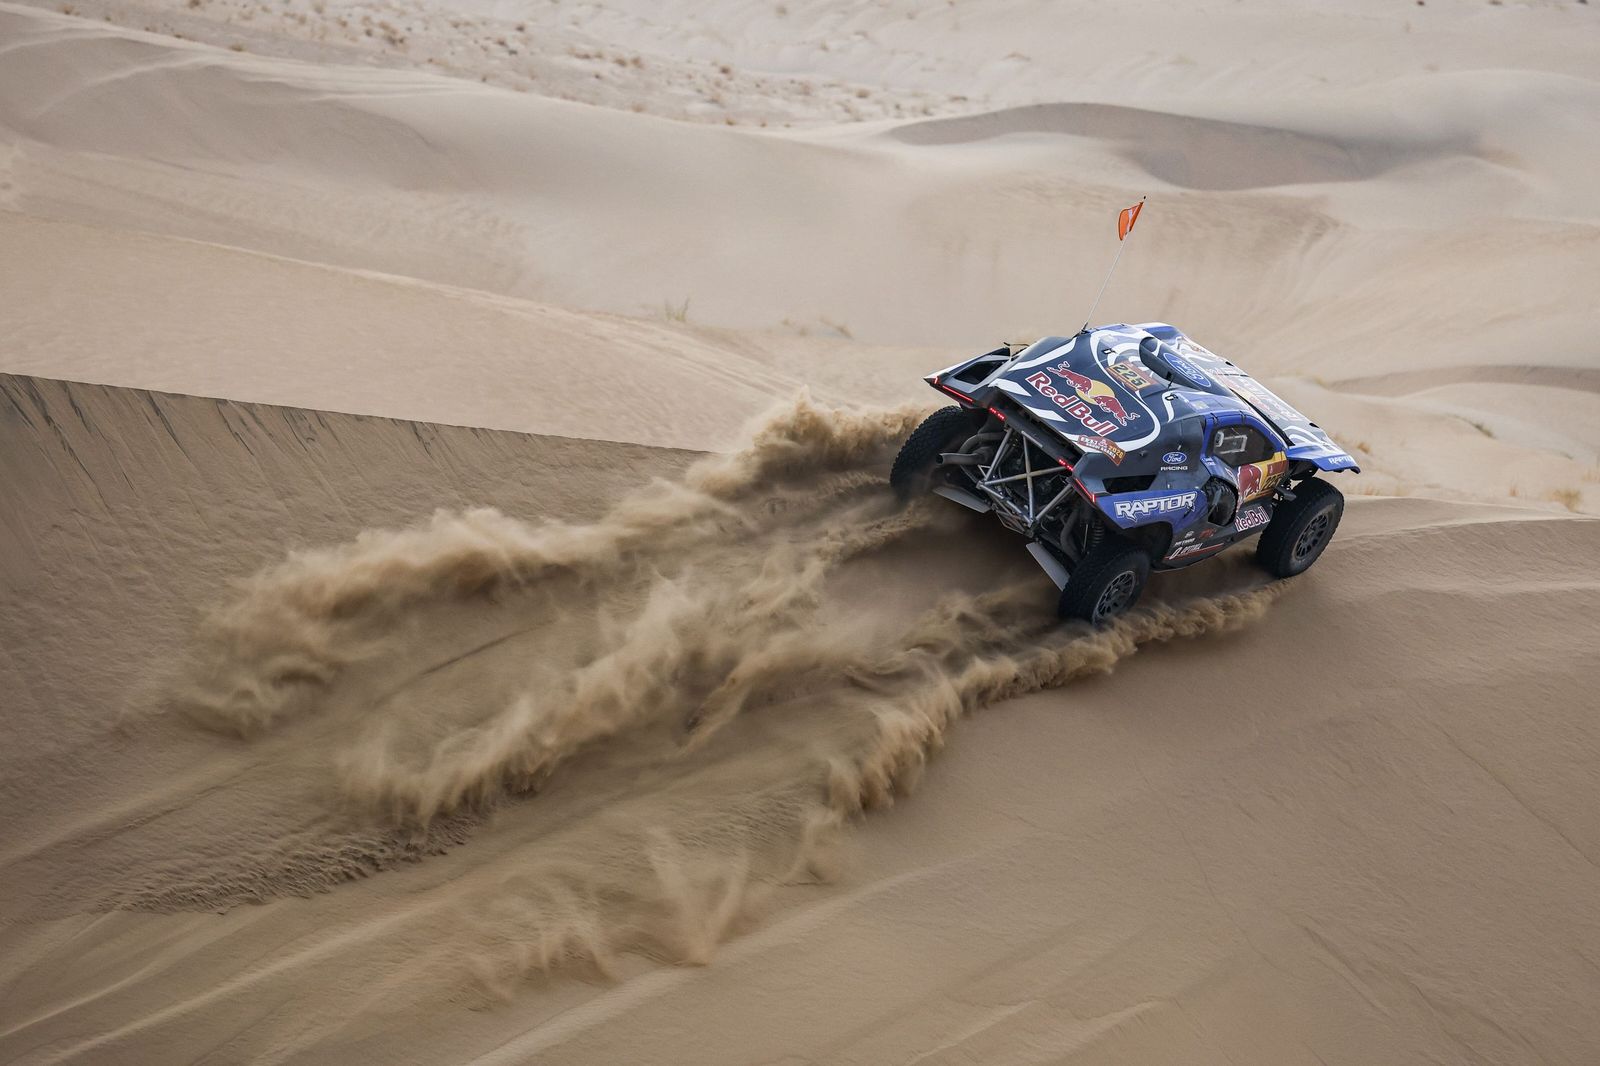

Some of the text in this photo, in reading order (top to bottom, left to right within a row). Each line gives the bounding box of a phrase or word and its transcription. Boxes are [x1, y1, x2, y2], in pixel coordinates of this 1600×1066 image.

[1113, 364, 1147, 387] 225
[1025, 371, 1120, 437] Red Bull
[1114, 491, 1198, 522] RAPTOR
[1235, 506, 1271, 532] Red Bull
